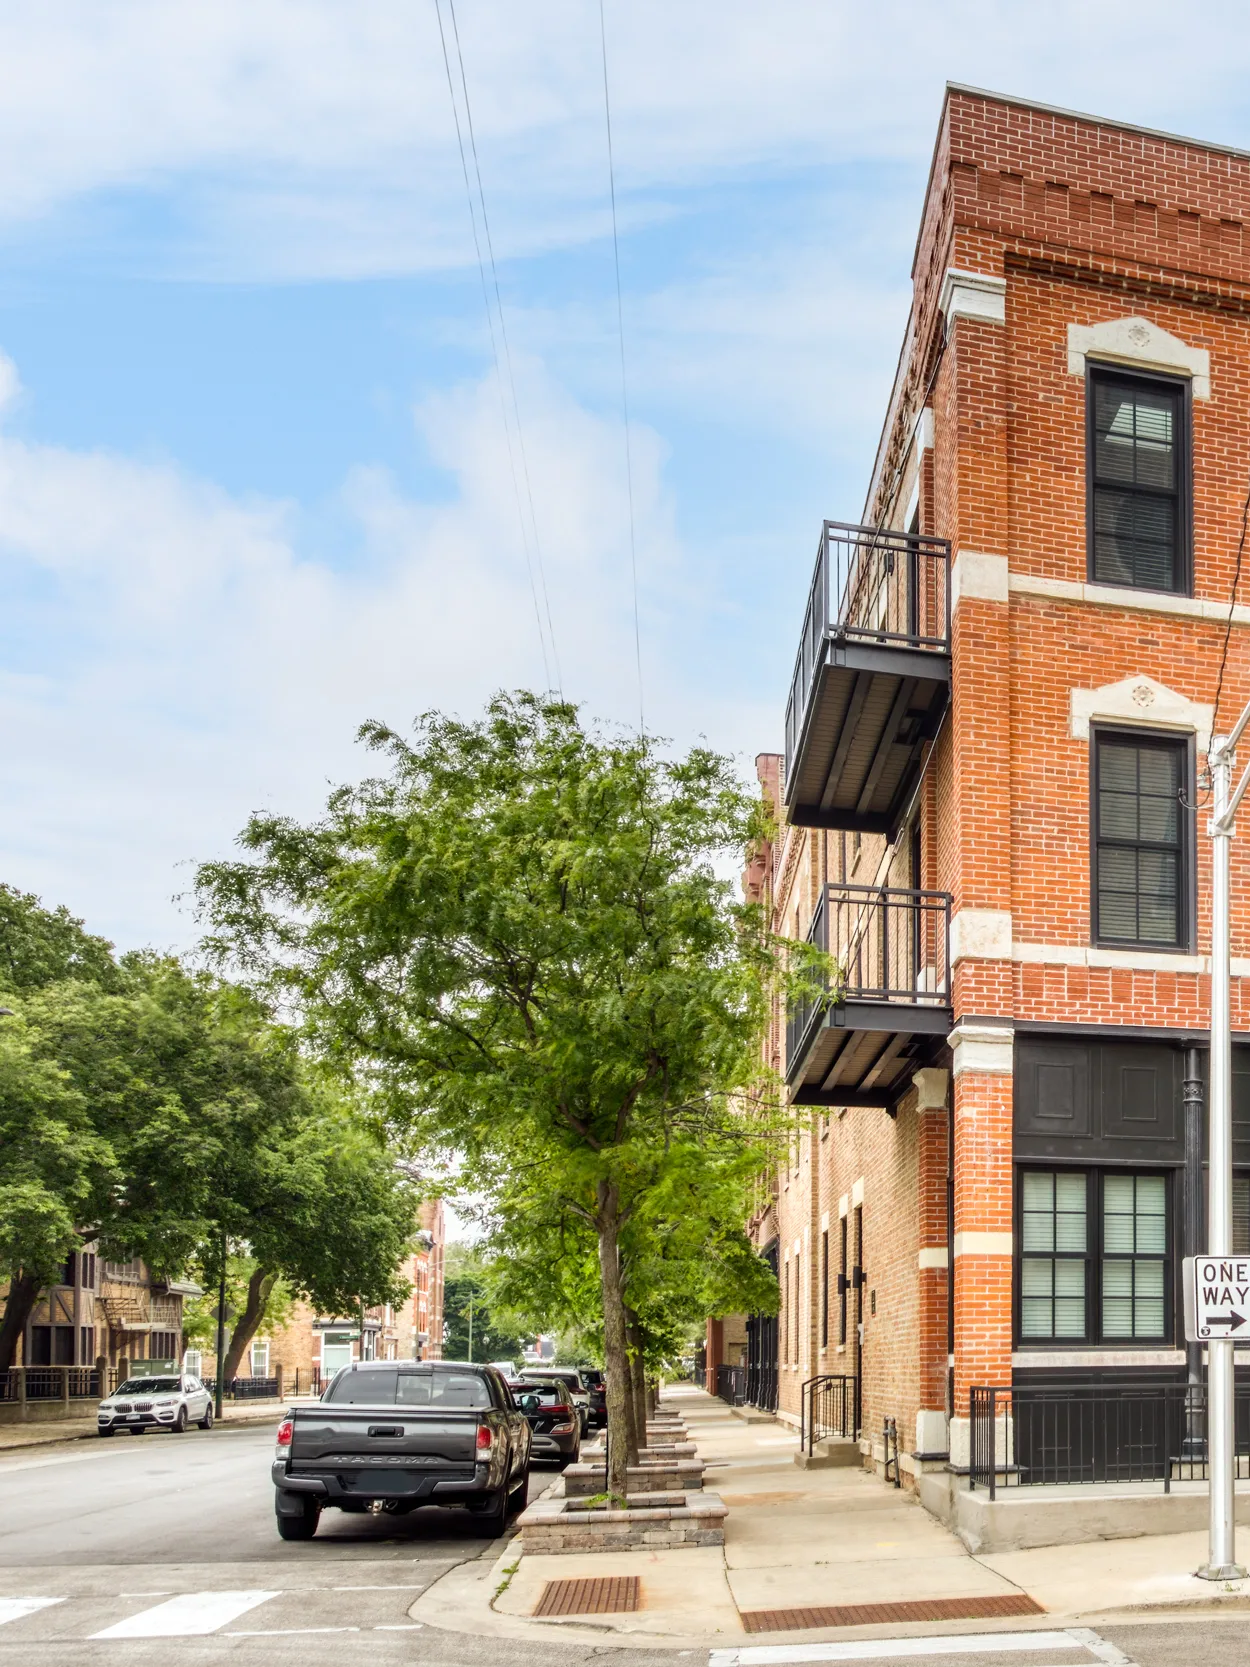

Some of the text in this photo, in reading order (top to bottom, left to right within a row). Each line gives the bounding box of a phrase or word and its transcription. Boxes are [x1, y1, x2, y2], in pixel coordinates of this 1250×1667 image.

[1203, 1264, 1248, 1282] ONE
[1203, 1287, 1249, 1305] WAY
[333, 1456, 438, 1464] TACOMA
